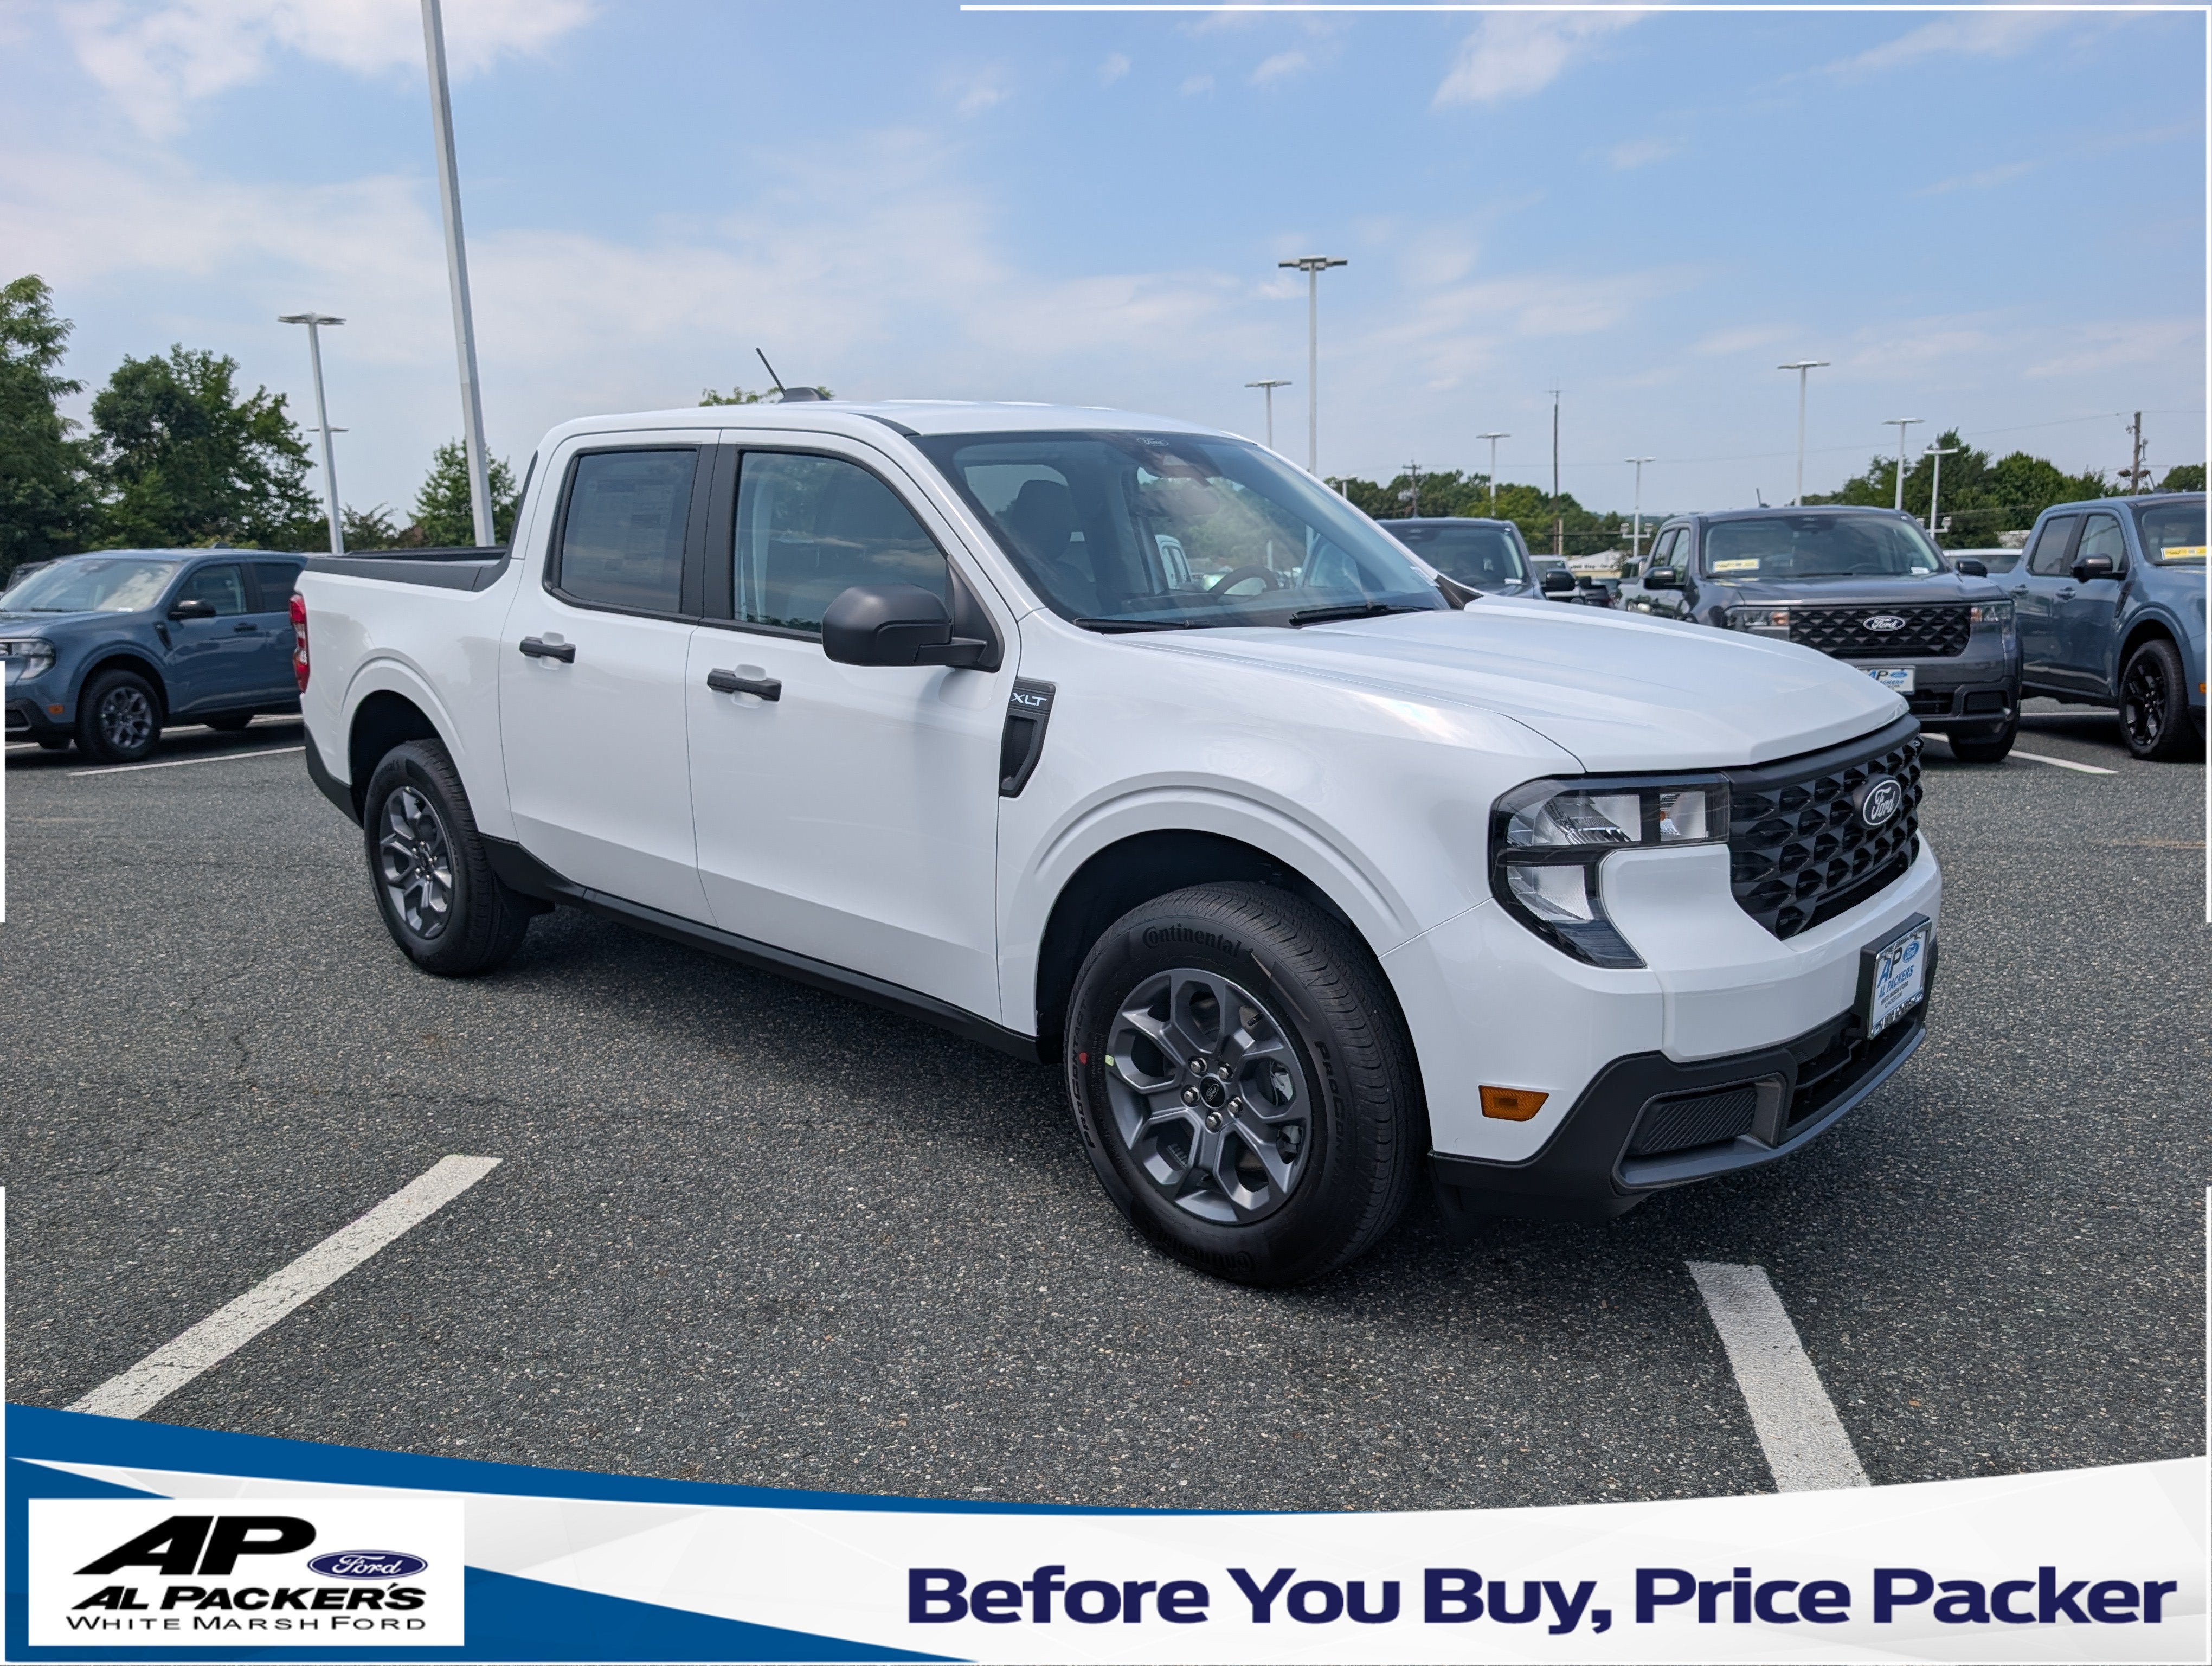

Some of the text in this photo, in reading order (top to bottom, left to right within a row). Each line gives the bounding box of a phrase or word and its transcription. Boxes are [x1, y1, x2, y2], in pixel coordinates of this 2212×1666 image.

[1871, 617, 1899, 630] Ford
[1010, 692, 1047, 707] XLT
[1870, 786, 1896, 821] Ford
[1142, 922, 1243, 958] Continental
[1876, 947, 1902, 989] AP
